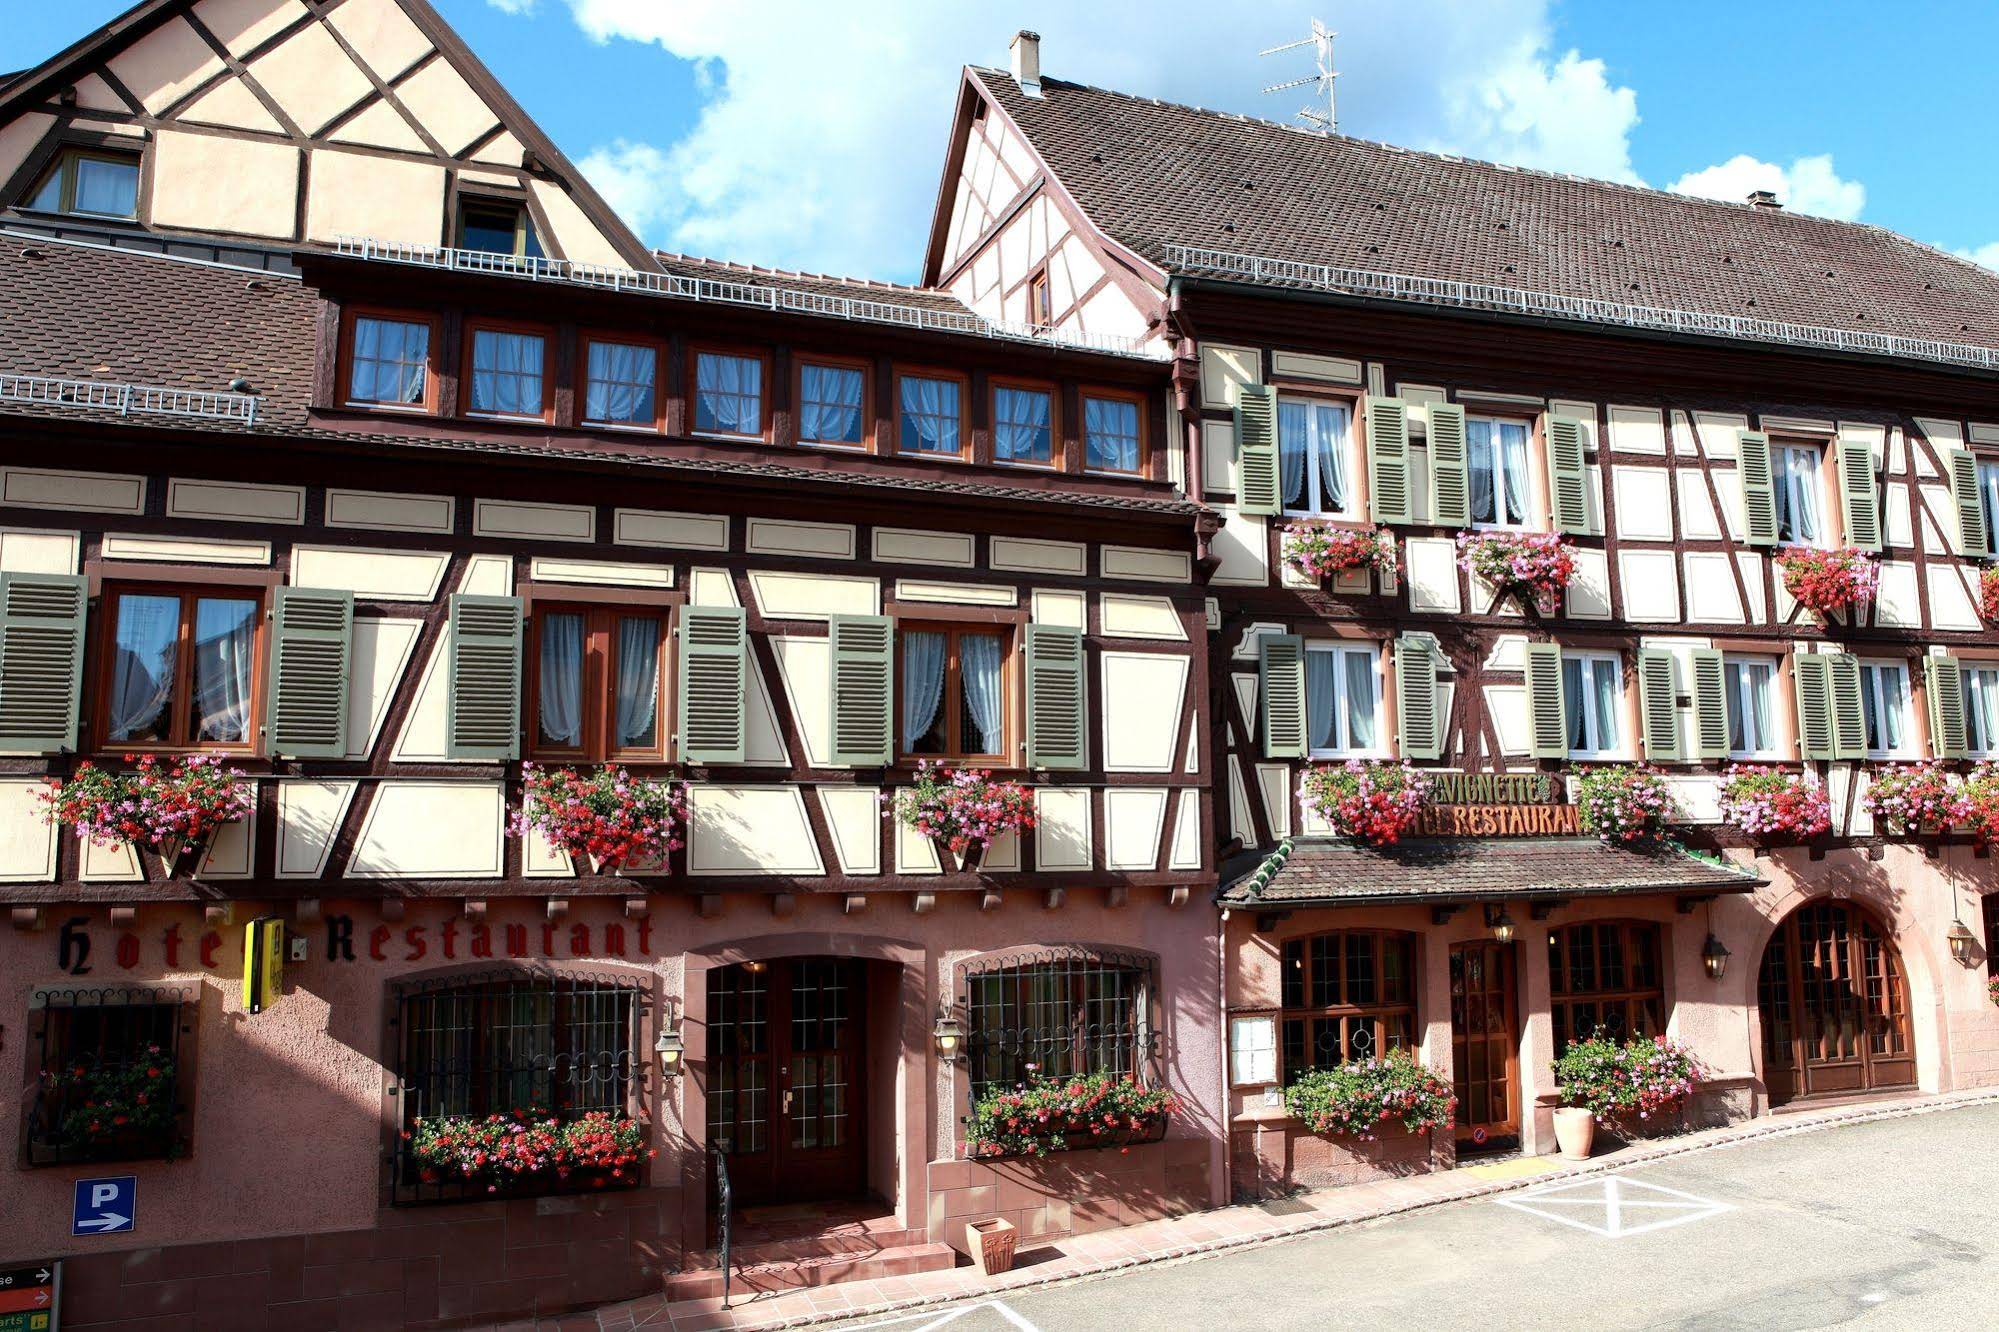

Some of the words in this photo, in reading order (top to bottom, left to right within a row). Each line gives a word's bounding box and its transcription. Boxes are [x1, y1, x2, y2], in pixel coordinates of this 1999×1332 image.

[1453, 805, 1590, 835] RESTAURAN
[58, 916, 246, 976] Hote
[325, 913, 655, 963] Restaurant
[92, 1183, 119, 1208] P
[0, 1276, 13, 1286] se
